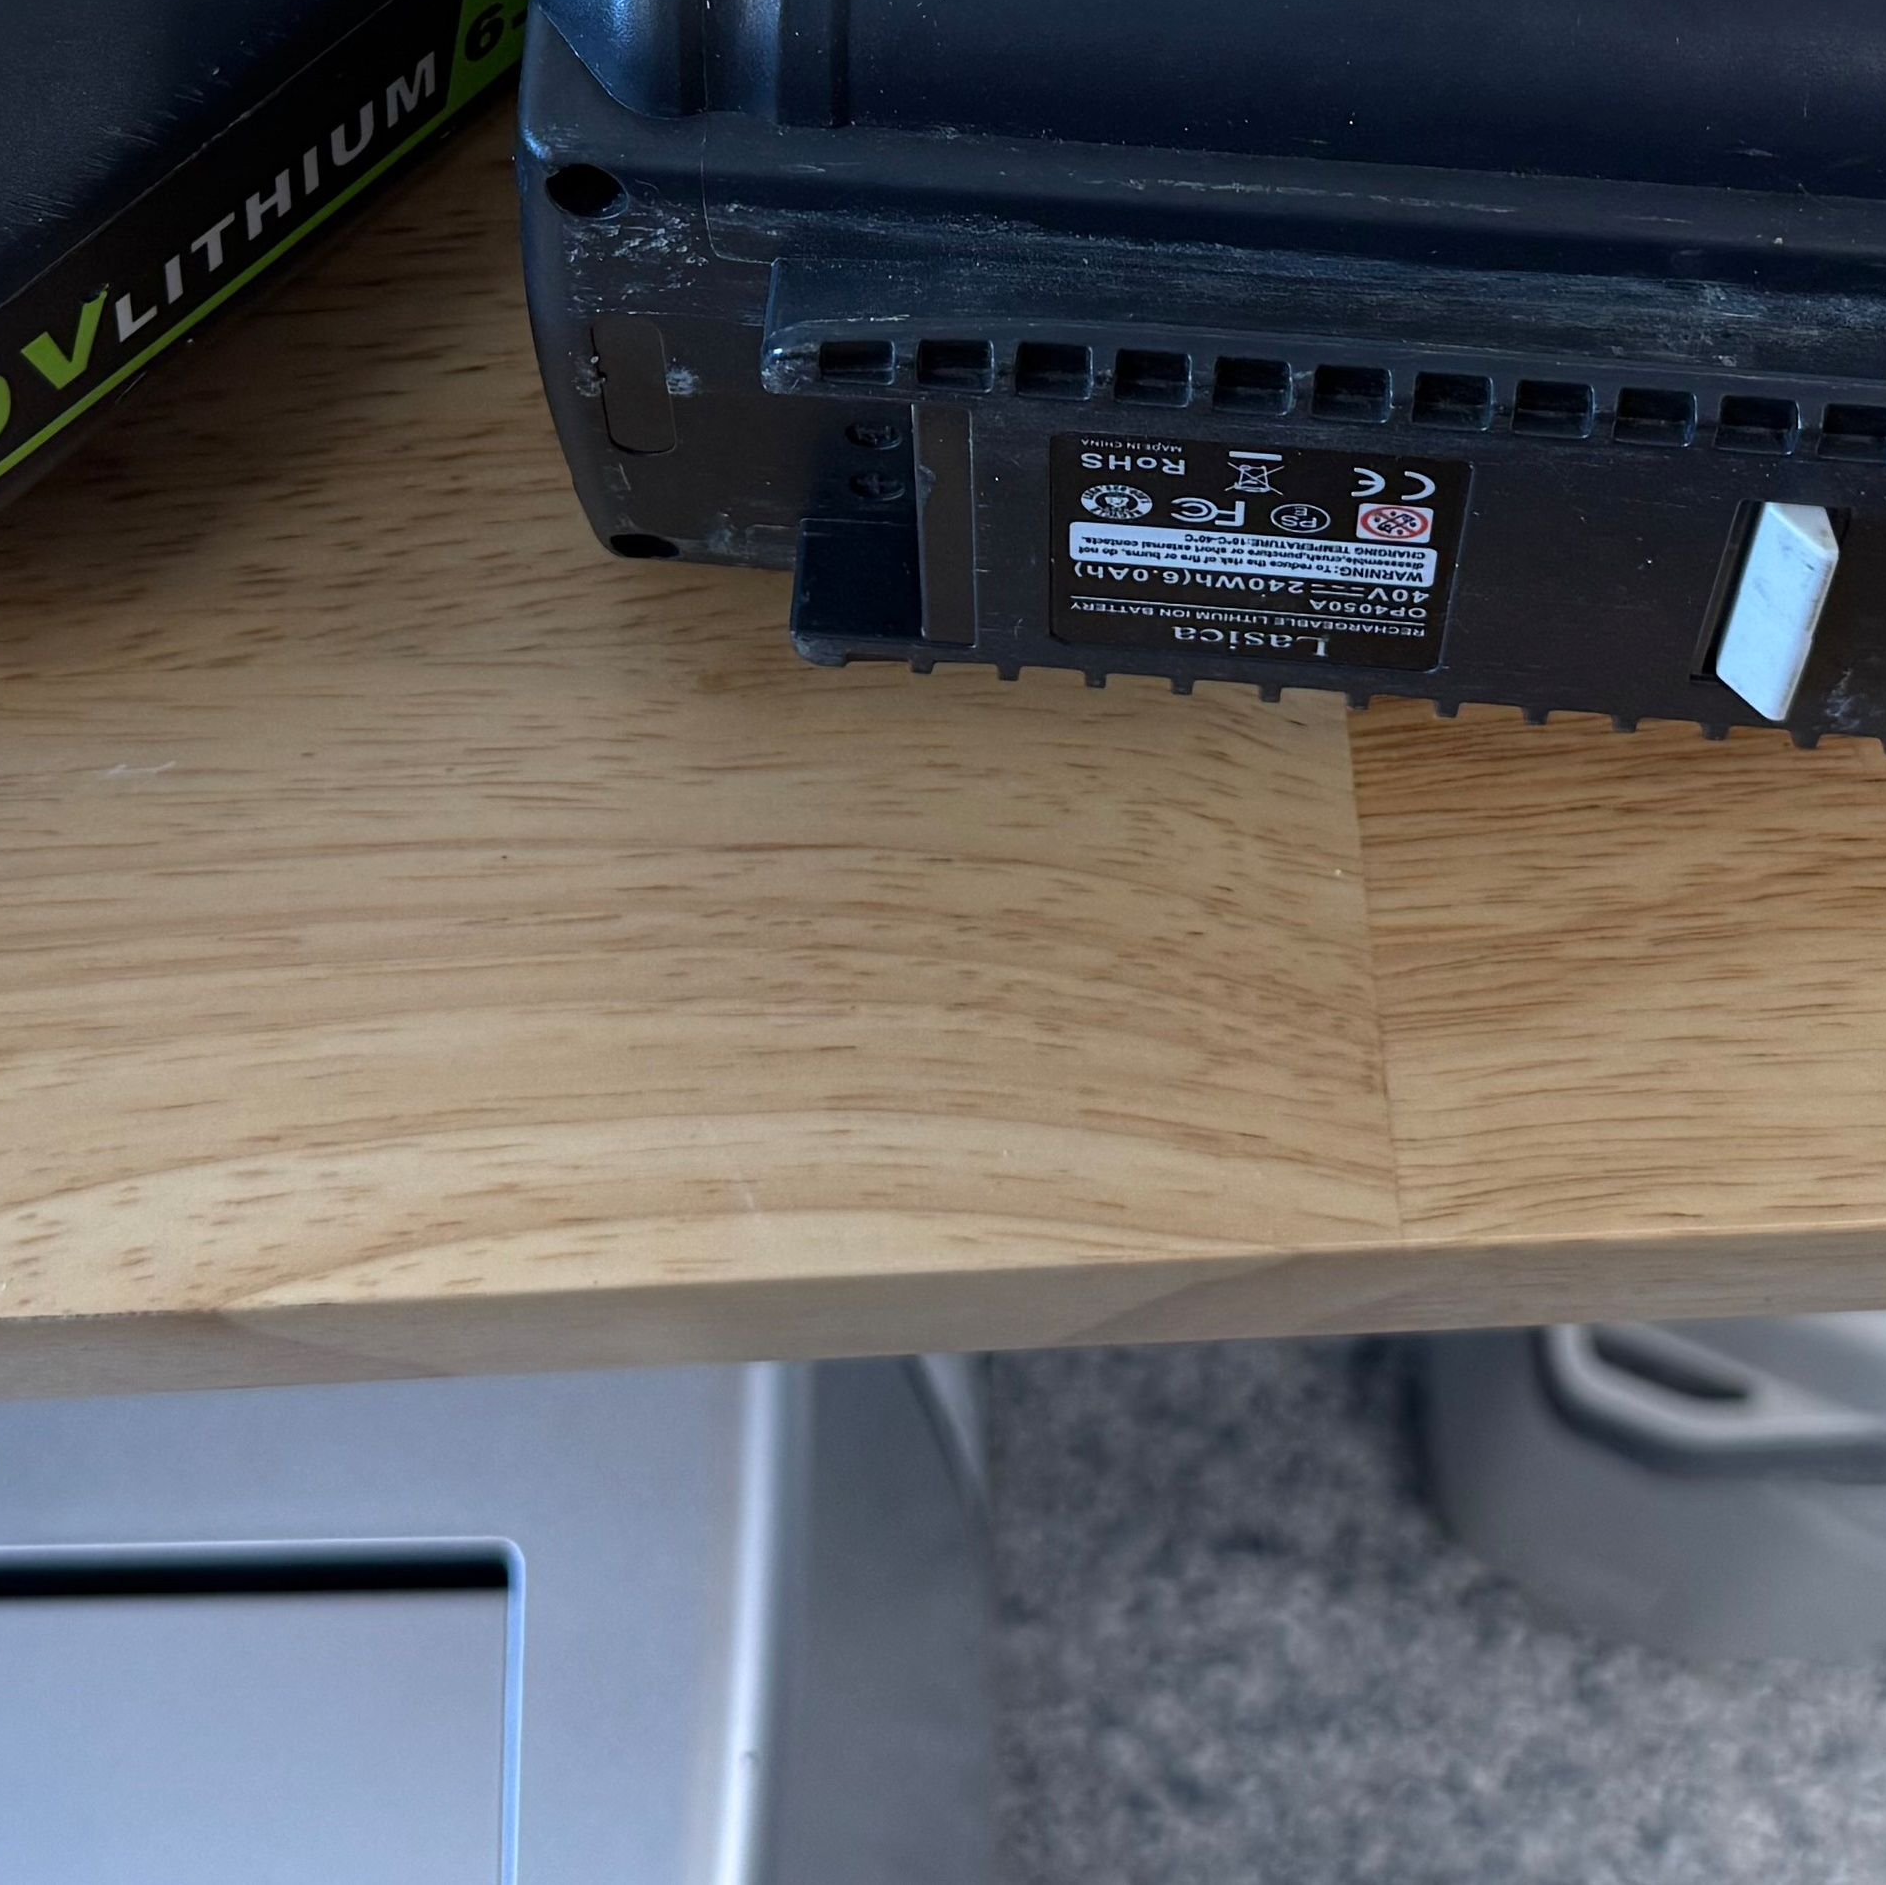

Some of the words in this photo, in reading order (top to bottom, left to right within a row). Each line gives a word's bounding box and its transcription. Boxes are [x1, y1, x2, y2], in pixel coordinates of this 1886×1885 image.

[115, 50, 438, 345] LITHIUM
[1080, 438, 1123, 449] CHINA
[1126, 441, 1141, 450] IN
[1080, 452, 1186, 476] RoHS
[1351, 467, 1436, 501] CE
[1079, 546, 1099, 555] not
[1103, 548, 1118, 557] do
[1354, 546, 1425, 560] CHARGING
[1180, 553, 1201, 563] fire
[1221, 556, 1243, 565] risk
[1246, 558, 1267, 568] the
[1269, 560, 1313, 572] reduce
[1317, 564, 1331, 574] To
[1333, 566, 1423, 582] WARNING:
[1069, 601, 1154, 616] BATTERY
[1159, 608, 1191, 618] ION
[1309, 599, 1427, 618] OP4050A
[1195, 610, 1268, 625] LITHIUM
[1273, 616, 1425, 637] RECHARGEABLE
[1171, 625, 1329, 658] Lasica
